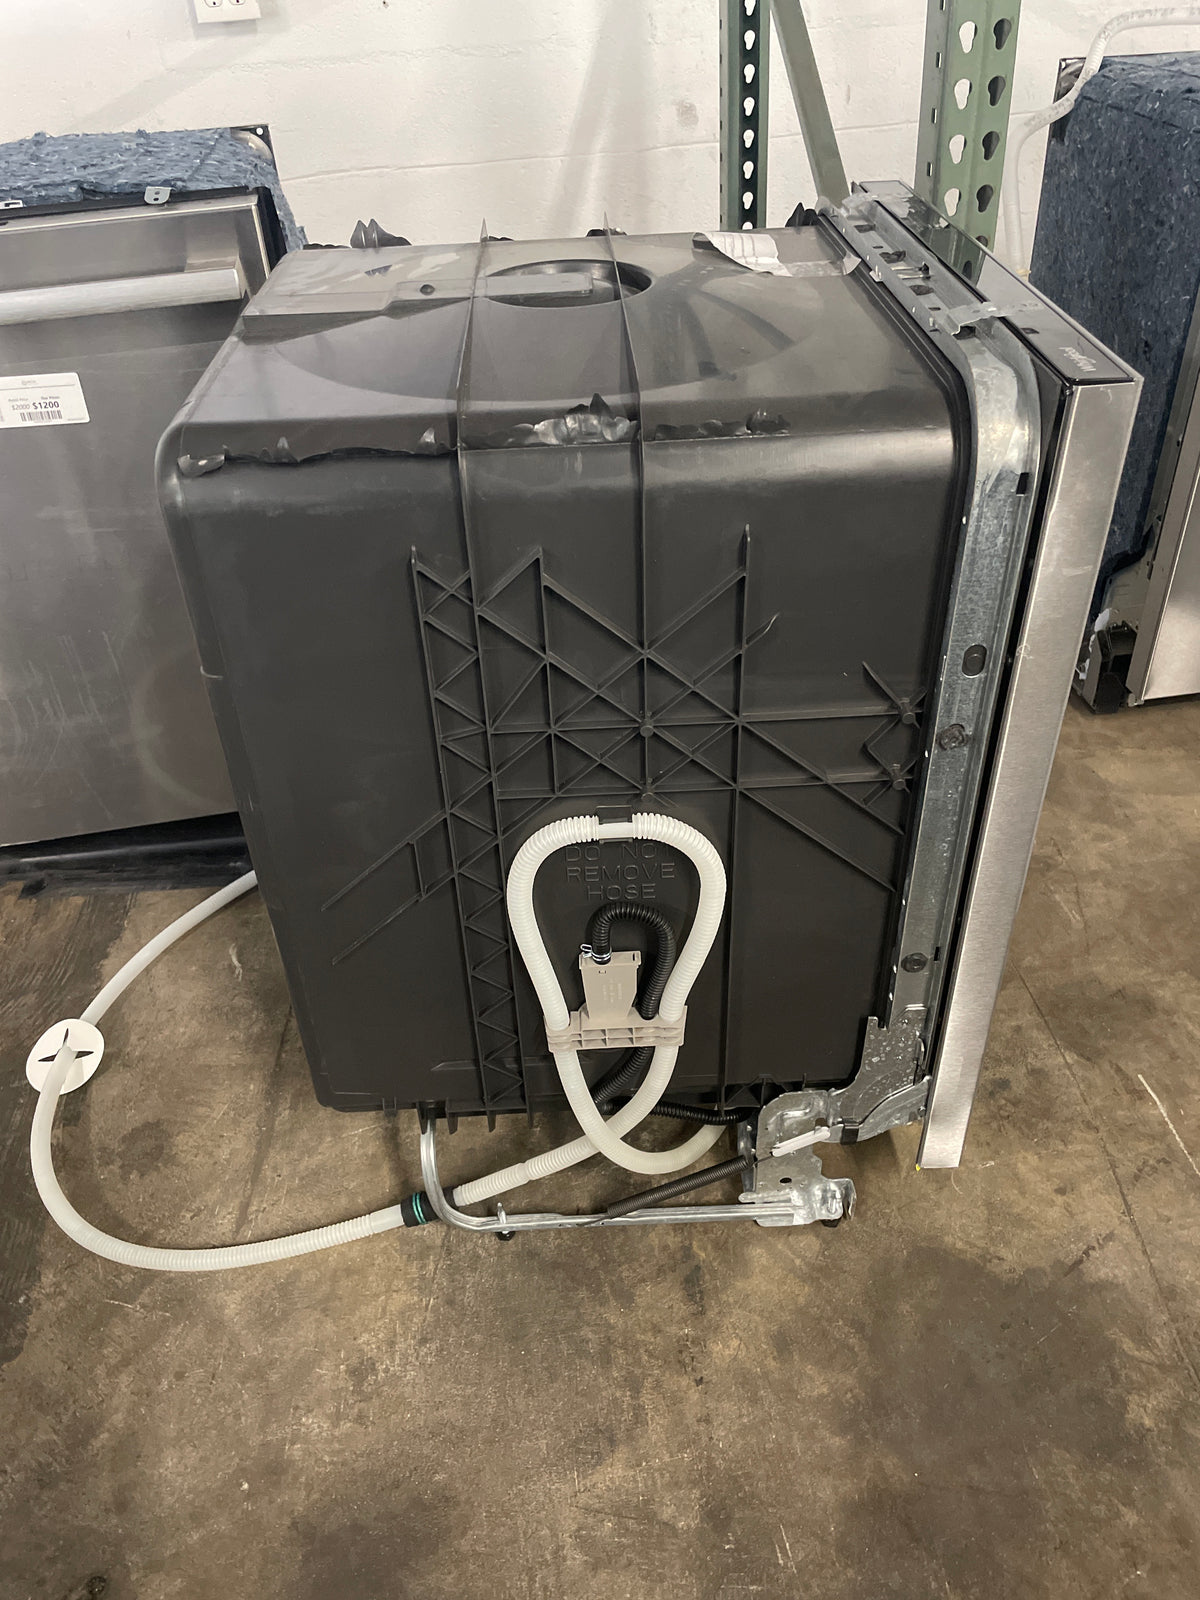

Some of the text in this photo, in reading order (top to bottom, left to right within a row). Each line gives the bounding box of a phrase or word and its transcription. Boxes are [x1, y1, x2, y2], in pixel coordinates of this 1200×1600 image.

[32, 401, 60, 410] $1200
[565, 846, 600, 862] DO
[565, 862, 676, 882] REMOVE
[586, 883, 656, 901] HOSE
